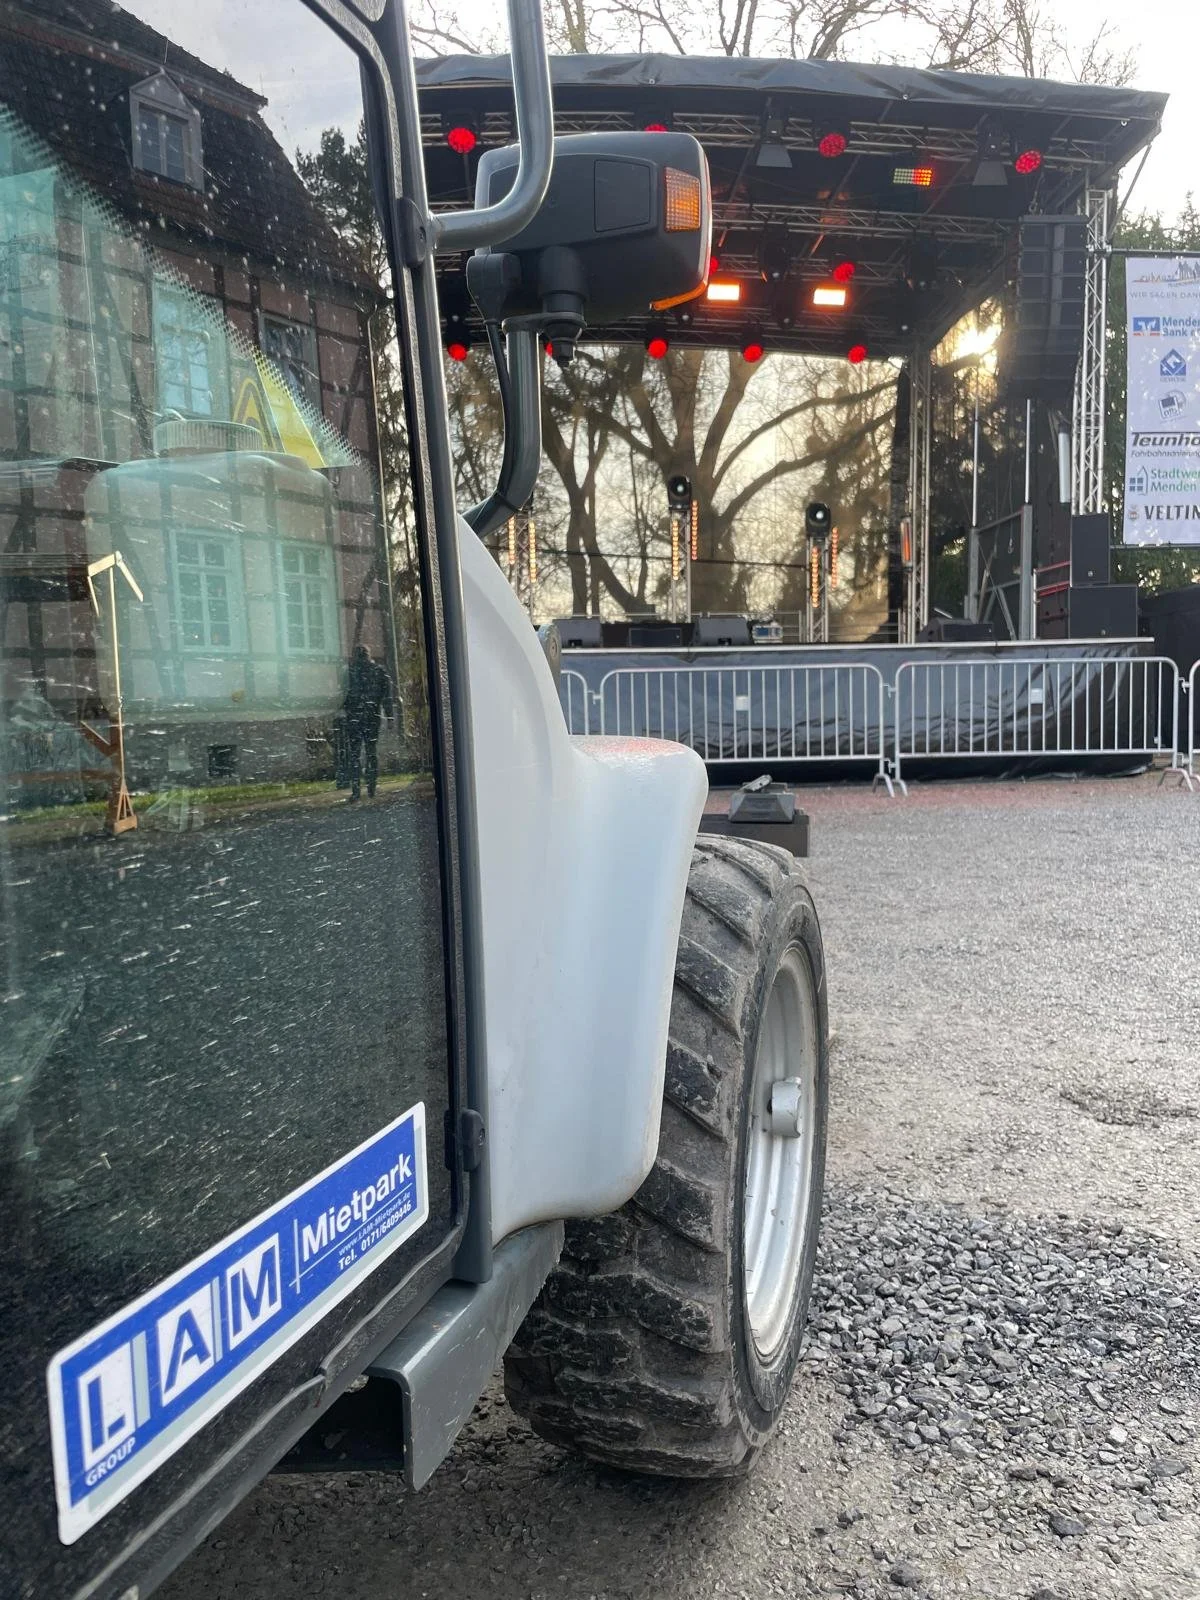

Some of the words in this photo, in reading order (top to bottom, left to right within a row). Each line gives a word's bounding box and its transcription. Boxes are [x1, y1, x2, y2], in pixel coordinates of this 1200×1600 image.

[1162, 327, 1188, 337] Bank
[1151, 480, 1197, 492] Menden
[302, 1153, 413, 1263] Mietpark
[338, 1248, 358, 1271] Tel.
[79, 1235, 282, 1470] LAM
[85, 1436, 136, 1487] GROUP
